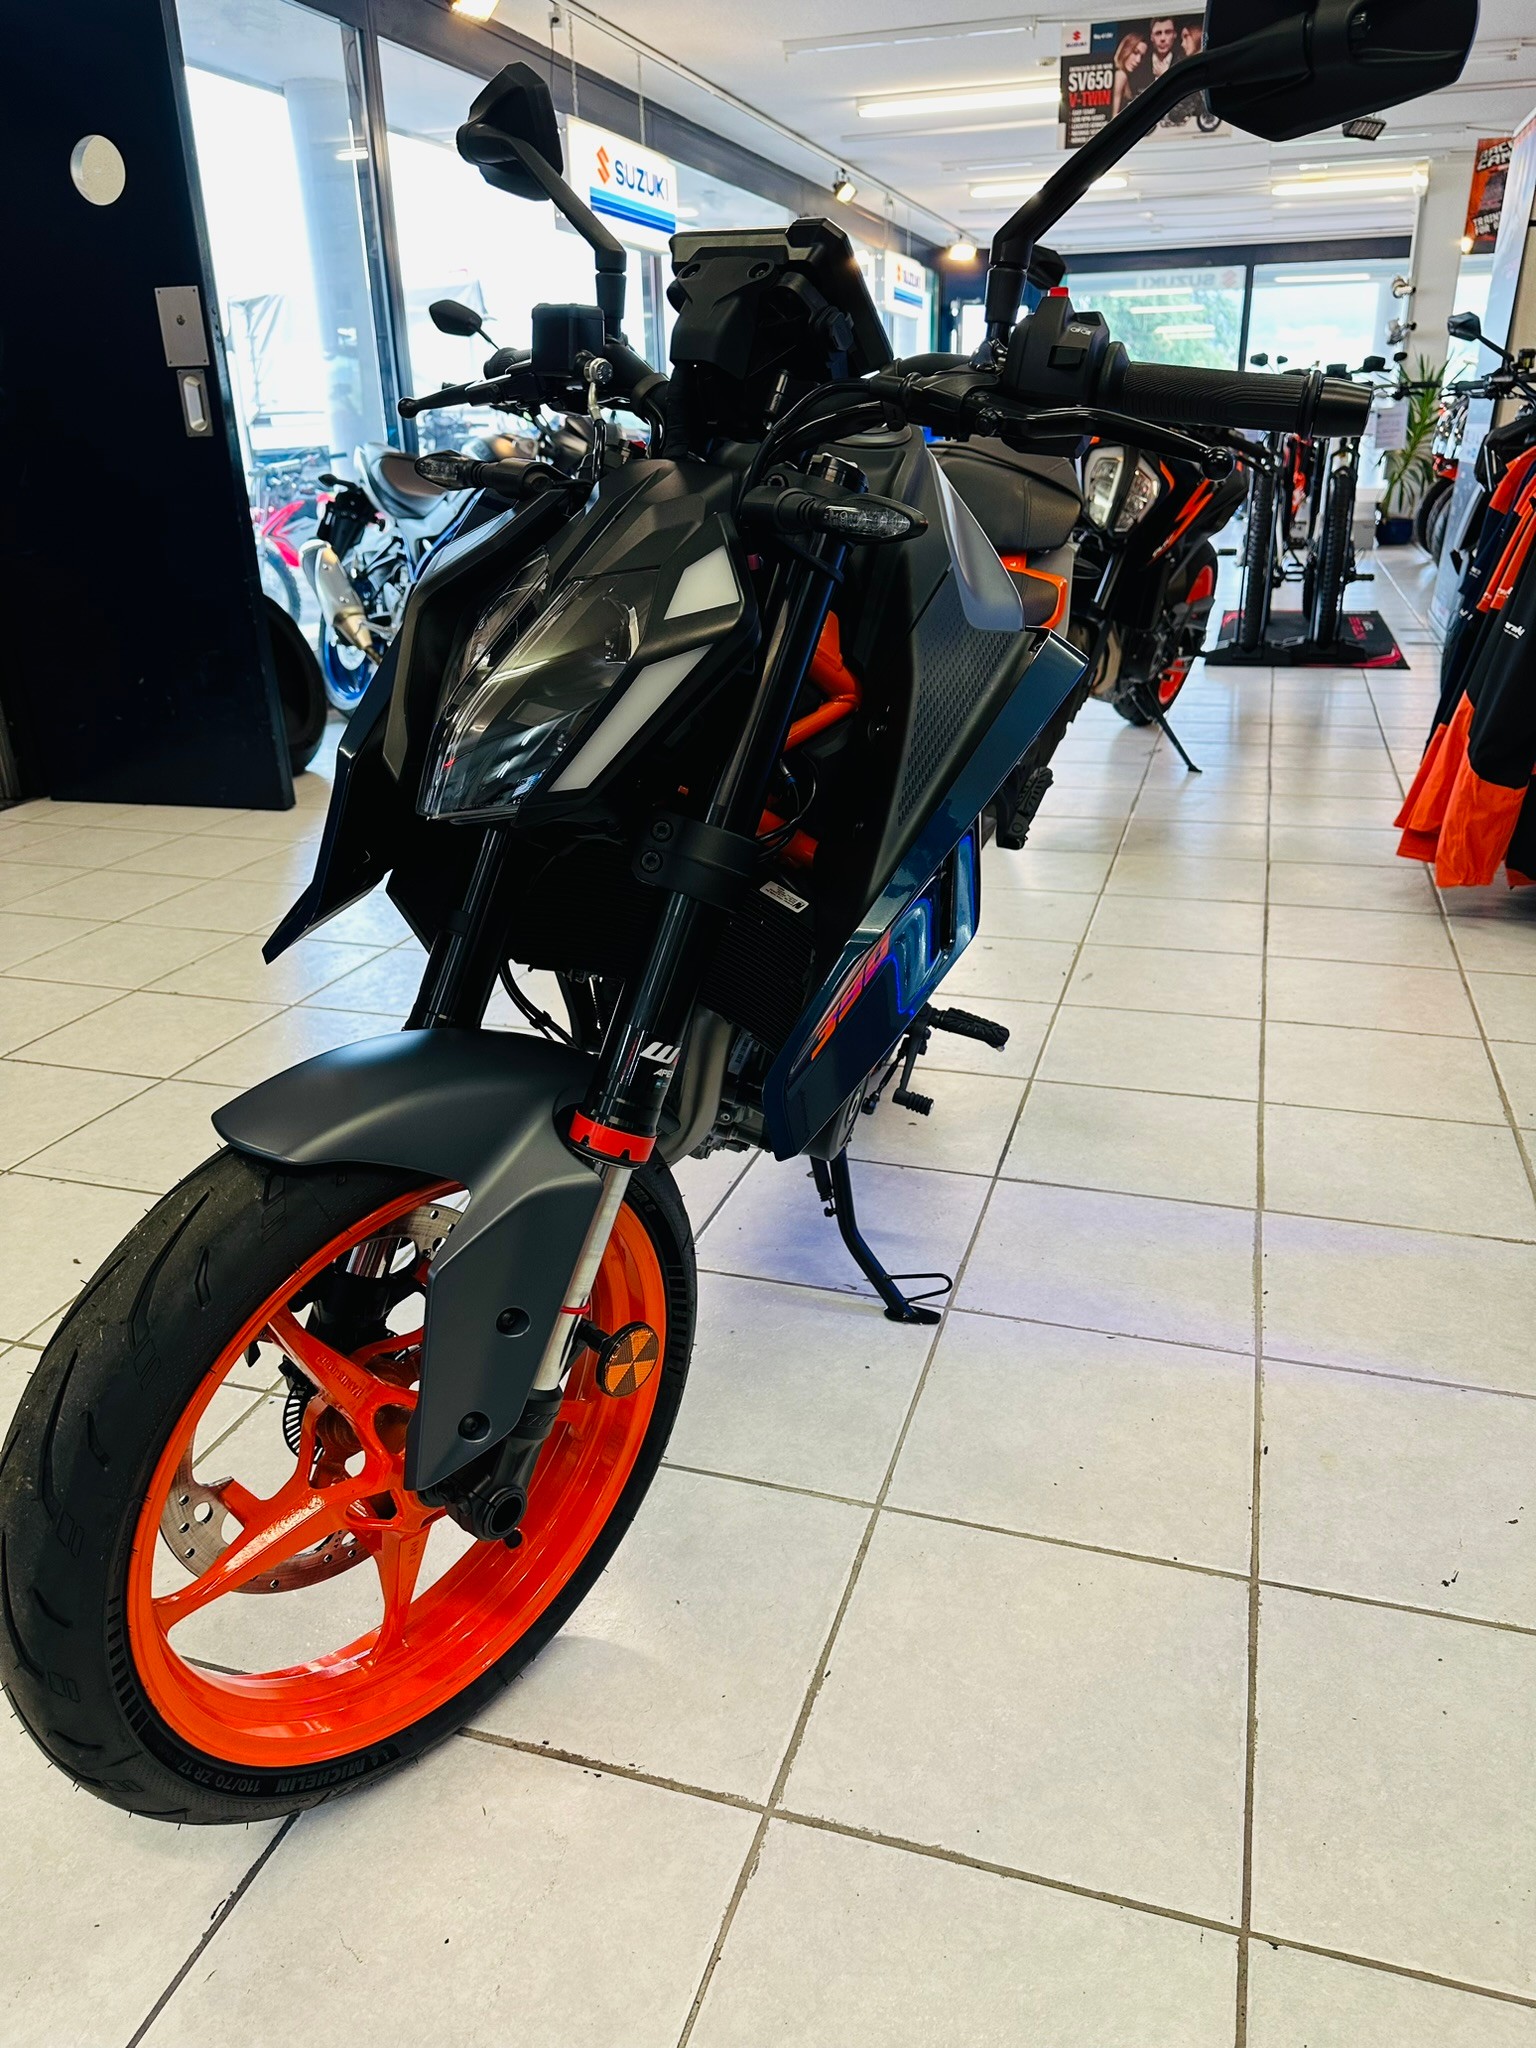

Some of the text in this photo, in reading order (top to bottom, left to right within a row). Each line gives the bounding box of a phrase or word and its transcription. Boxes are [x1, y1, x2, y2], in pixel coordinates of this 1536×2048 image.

[1068, 70, 1113, 92] SV650
[1069, 90, 1112, 107] V-TWIN
[615, 160, 669, 201] SUZUKI
[177, 1758, 367, 1793] MICHELIN 110/70 ZR 17
